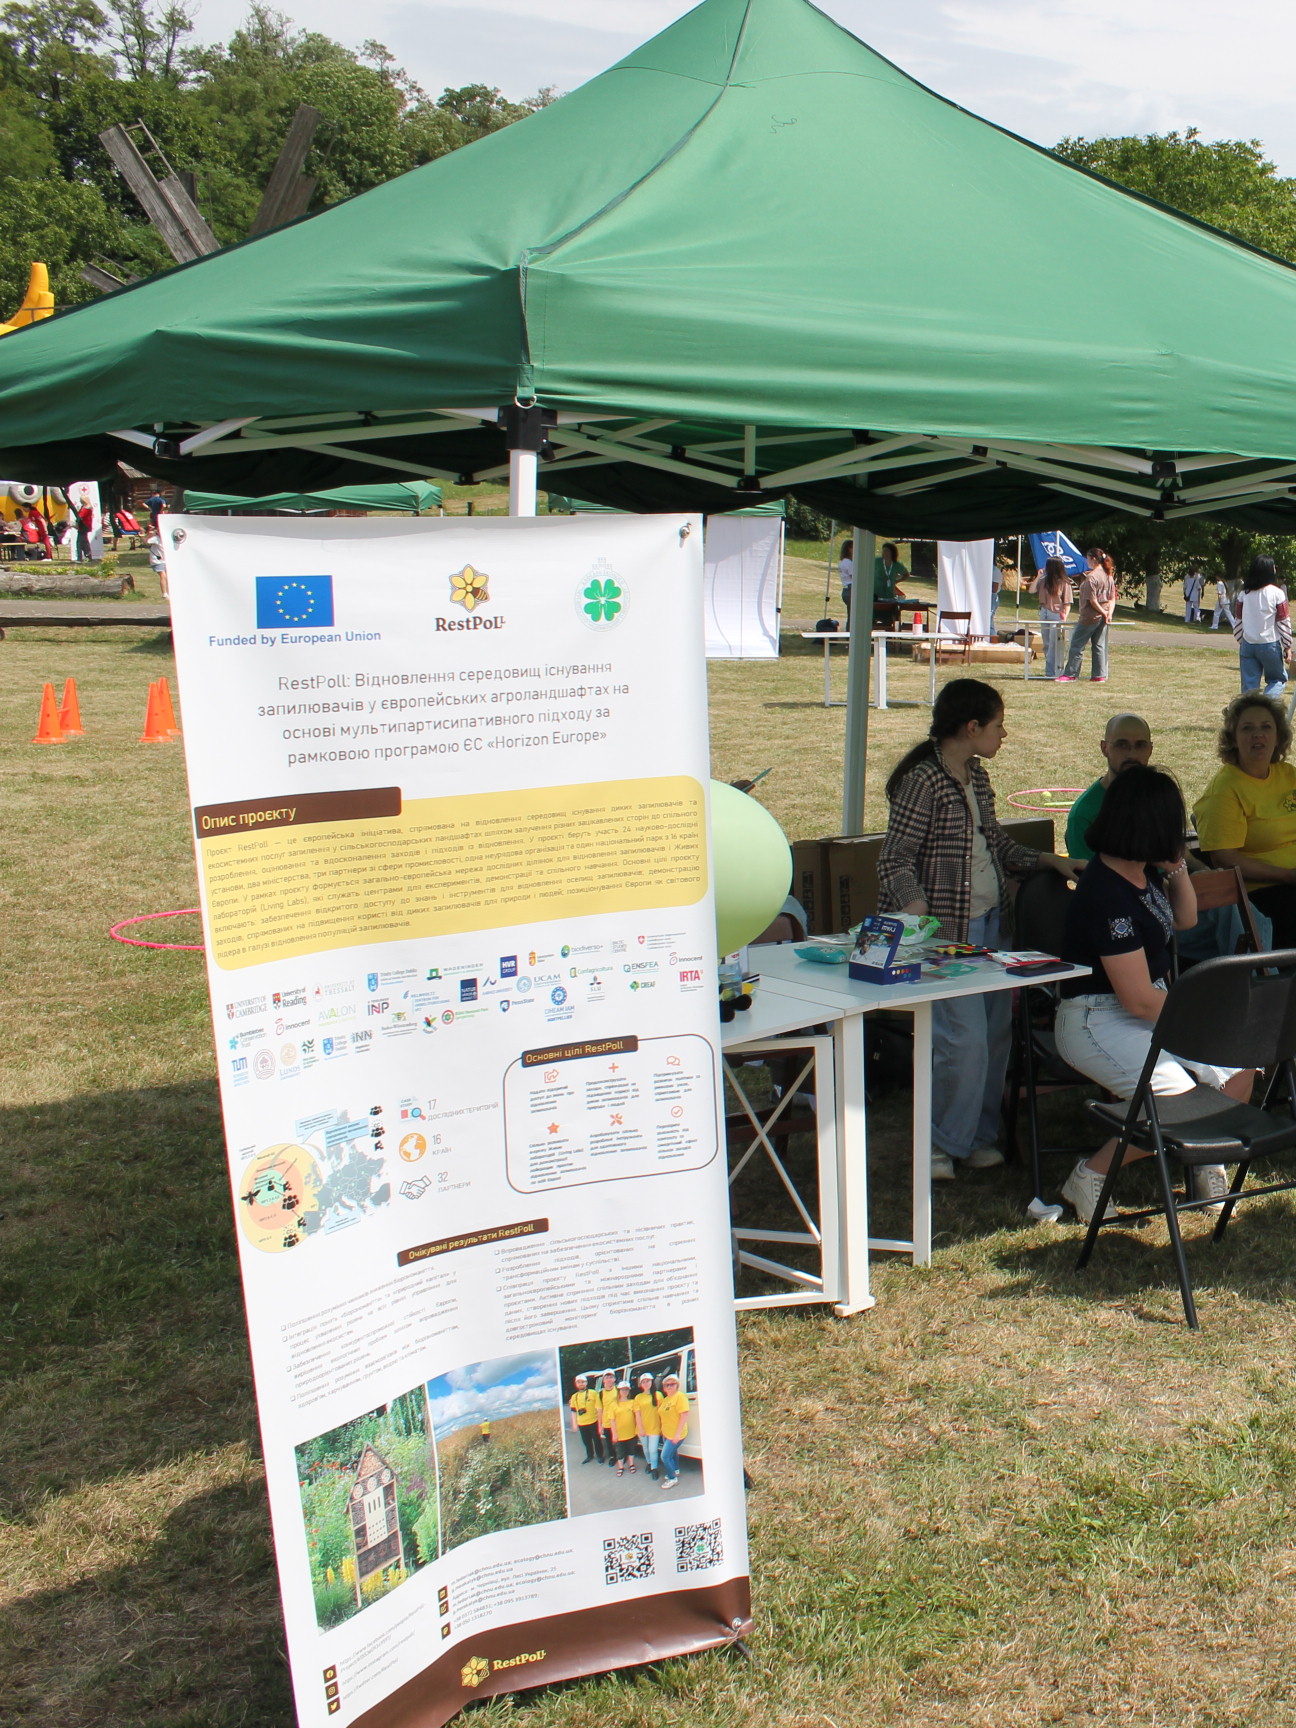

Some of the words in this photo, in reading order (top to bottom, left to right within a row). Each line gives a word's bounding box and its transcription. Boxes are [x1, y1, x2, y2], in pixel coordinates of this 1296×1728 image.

[208, 634, 257, 647] Funded
[260, 633, 277, 648] by
[280, 632, 342, 646] European
[345, 630, 381, 642] Union
[278, 673, 352, 691] RestPoll:
[354, 671, 455, 688] Відновлення
[458, 667, 541, 684] середовищ
[544, 662, 612, 679] існування
[257, 697, 364, 717] запилювачів
[368, 700, 377, 714] у
[380, 691, 487, 712] європейських
[490, 684, 610, 705] агроландшафтах
[613, 684, 630, 695] на
[282, 722, 336, 740] основі
[340, 713, 535, 740] мультипартисипативного
[538, 708, 593, 723] підходу
[595, 707, 610, 718] за
[287, 748, 370, 768] рамковою
[374, 742, 460, 761] програмою
[463, 737, 483, 752] ЄС
[486, 734, 549, 749] «Horizon
[552, 730, 607, 745] Europe»
[201, 815, 237, 830] Опис
[239, 807, 297, 827] проєкту
[206, 847, 232, 858] Проєкт
[237, 840, 269, 852] RestPoll
[287, 837, 298, 845] це
[302, 831, 355, 844] європейська
[360, 828, 404, 837] ініціатива,
[408, 822, 456, 834] спрямована
[475, 815, 522, 826] відновлення
[526, 811, 567, 822] середовищ
[571, 807, 606, 817] існування
[610, 804, 633, 812] диких
[637, 799, 684, 810] запилювачів
[207, 856, 259, 870] екосистемних
[260, 851, 286, 861] послуг
[287, 846, 331, 857] запилення
[339, 837, 433, 851] сільськогосподарських
[434, 831, 483, 842] ландшафтах
[484, 828, 513, 837] шляхом
[514, 824, 552, 834] залучення
[553, 821, 576, 831] різних
[577, 816, 625, 827] зацікавлених
[626, 813, 650, 822] сторін
[662, 810, 698, 819] спільного
[211, 897, 240, 908] Європи.
[250, 890, 277, 903] рамках
[279, 885, 310, 897] проєкту
[312, 879, 360, 891] формується
[362, 869, 452, 885] загально-європейська
[454, 866, 484, 875] мережа
[486, 861, 523, 871] дослідних
[526, 857, 554, 867] ділянок
[556, 855, 570, 863] для
[572, 850, 617, 861] відновлення
[619, 844, 666, 856] запилювачів
[673, 843, 699, 851] Живих
[632, 961, 659, 969] ENSFEA
[534, 974, 561, 982] UCAM
[236, 1003, 268, 1018] CAMBRIDGE
[283, 996, 307, 1008] Reading
[319, 1005, 356, 1021] AVALON
[286, 1020, 310, 1030] innocent
[526, 1050, 562, 1063] Основні
[565, 1047, 583, 1058] цілі
[585, 1041, 624, 1054] RestPoll
[428, 1099, 436, 1110] 17
[428, 1108, 465, 1121] ДОСЛІДНИХ
[432, 1134, 441, 1145] 16
[438, 1172, 448, 1183] 32
[438, 1181, 471, 1192] ПАРТНЕРИ
[408, 1242, 448, 1259] Очікувані
[449, 1232, 497, 1250] результати
[499, 1224, 534, 1238] RestPoll
